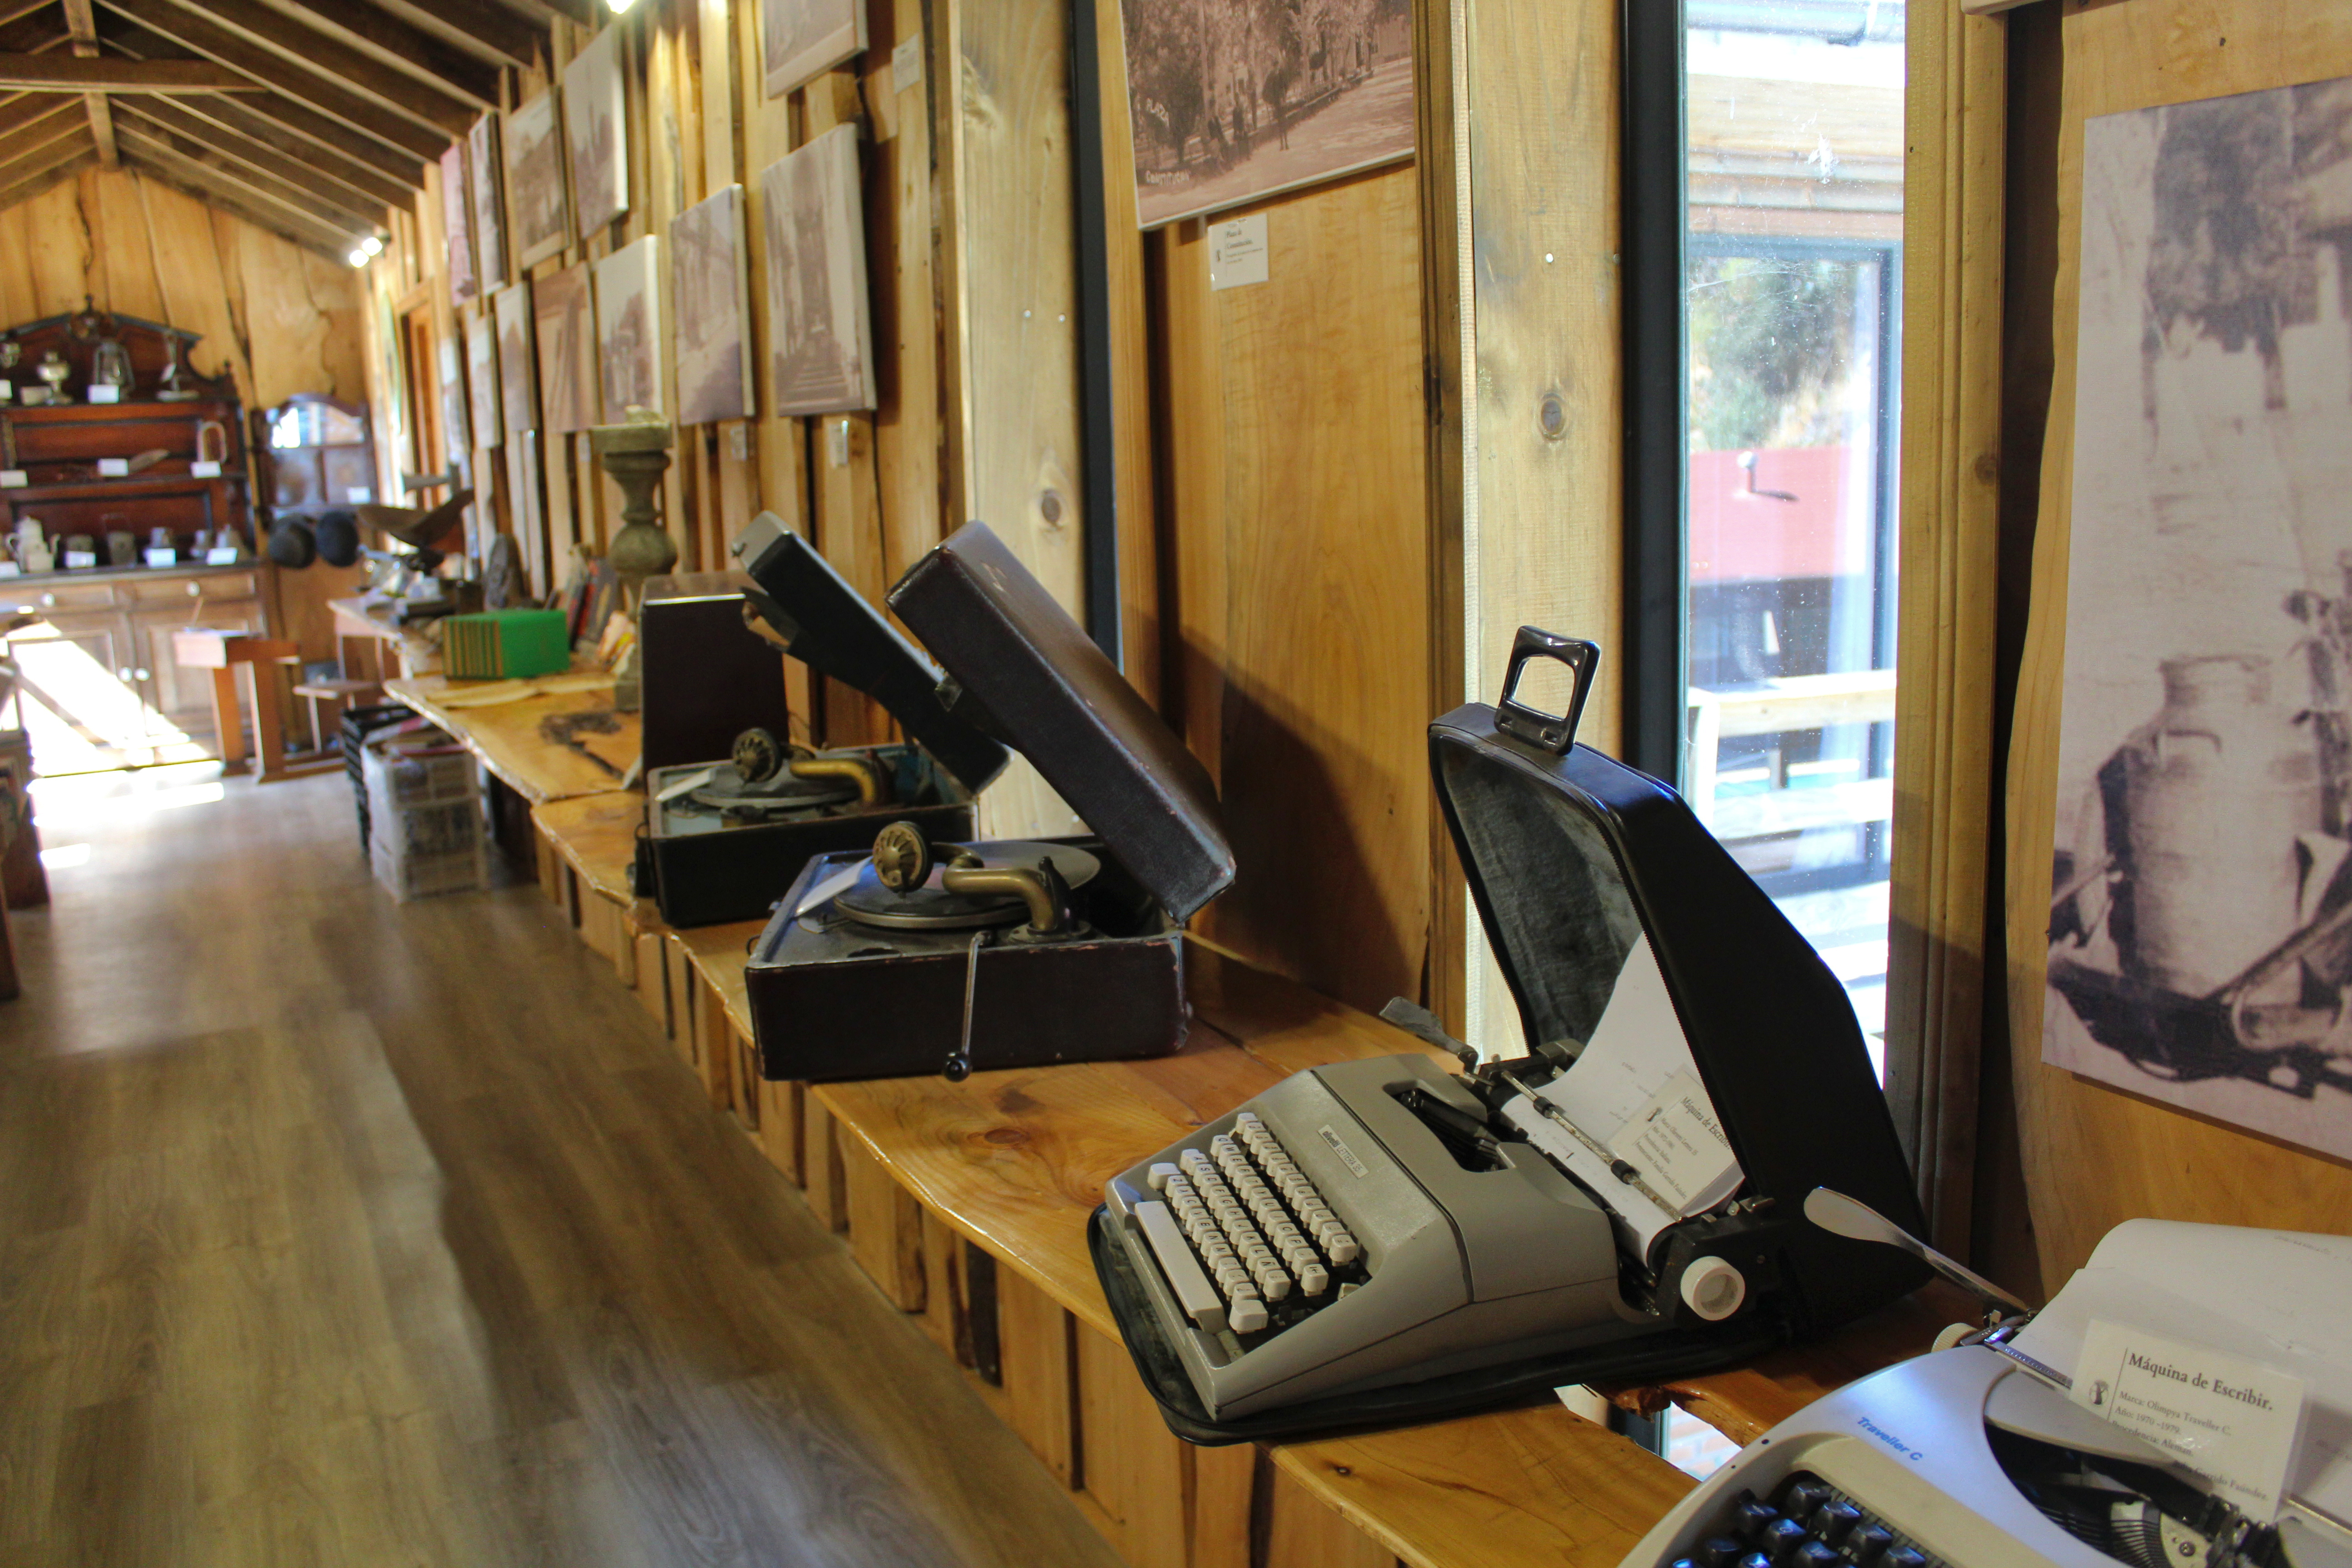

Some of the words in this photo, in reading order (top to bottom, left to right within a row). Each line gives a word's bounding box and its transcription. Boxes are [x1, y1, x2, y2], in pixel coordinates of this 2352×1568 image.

[1147, 98, 1170, 127] PLAZA
[1680, 1097, 1704, 1121] Máquina
[1702, 1117, 1711, 1127] de
[1323, 1131, 1341, 1147] olivetti
[1337, 1147, 1357, 1166] LETTERA
[2129, 1352, 2188, 1382] Máquina
[2192, 1372, 2209, 1388] de
[2212, 1378, 2273, 1411] Escribir.
[2115, 1406, 2133, 1419] Año:
[2136, 1413, 2155, 1426] 1970
[2120, 1391, 2145, 1406] Marca:
[2184, 1411, 2220, 1431] Traveller
[1857, 1416, 1910, 1452] Traveller
[1910, 1452, 1923, 1460] C
